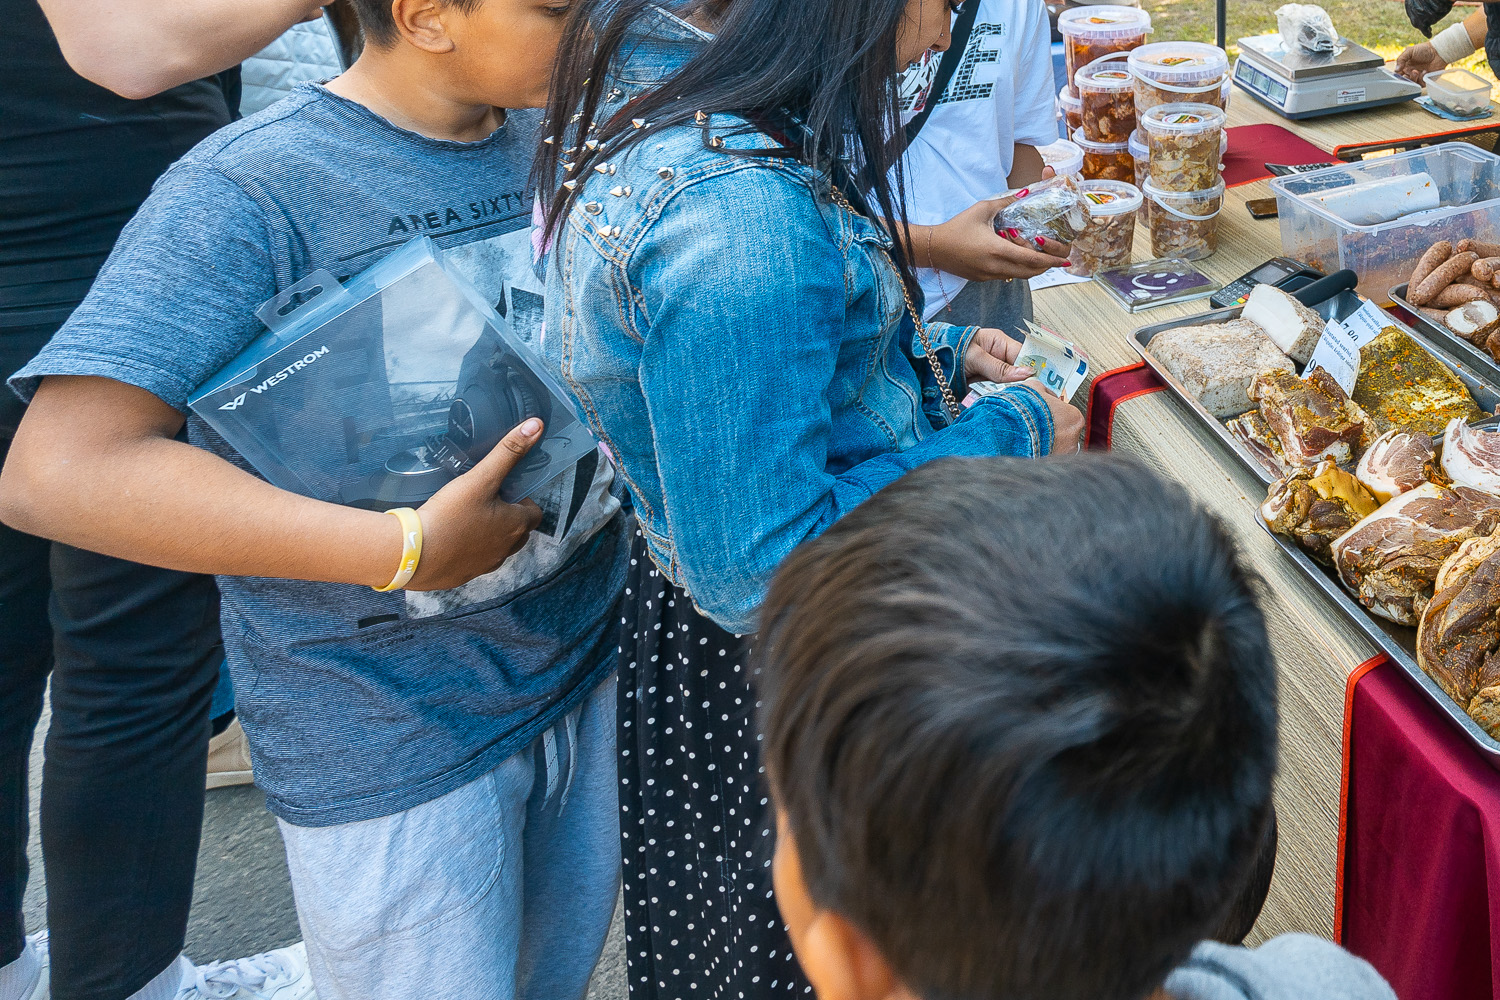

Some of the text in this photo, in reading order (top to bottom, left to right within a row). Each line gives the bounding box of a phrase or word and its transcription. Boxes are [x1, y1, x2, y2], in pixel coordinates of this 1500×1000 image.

[388, 207, 462, 236] AREA
[250, 345, 330, 394] WESTROM
[1046, 370, 1065, 391] 5
